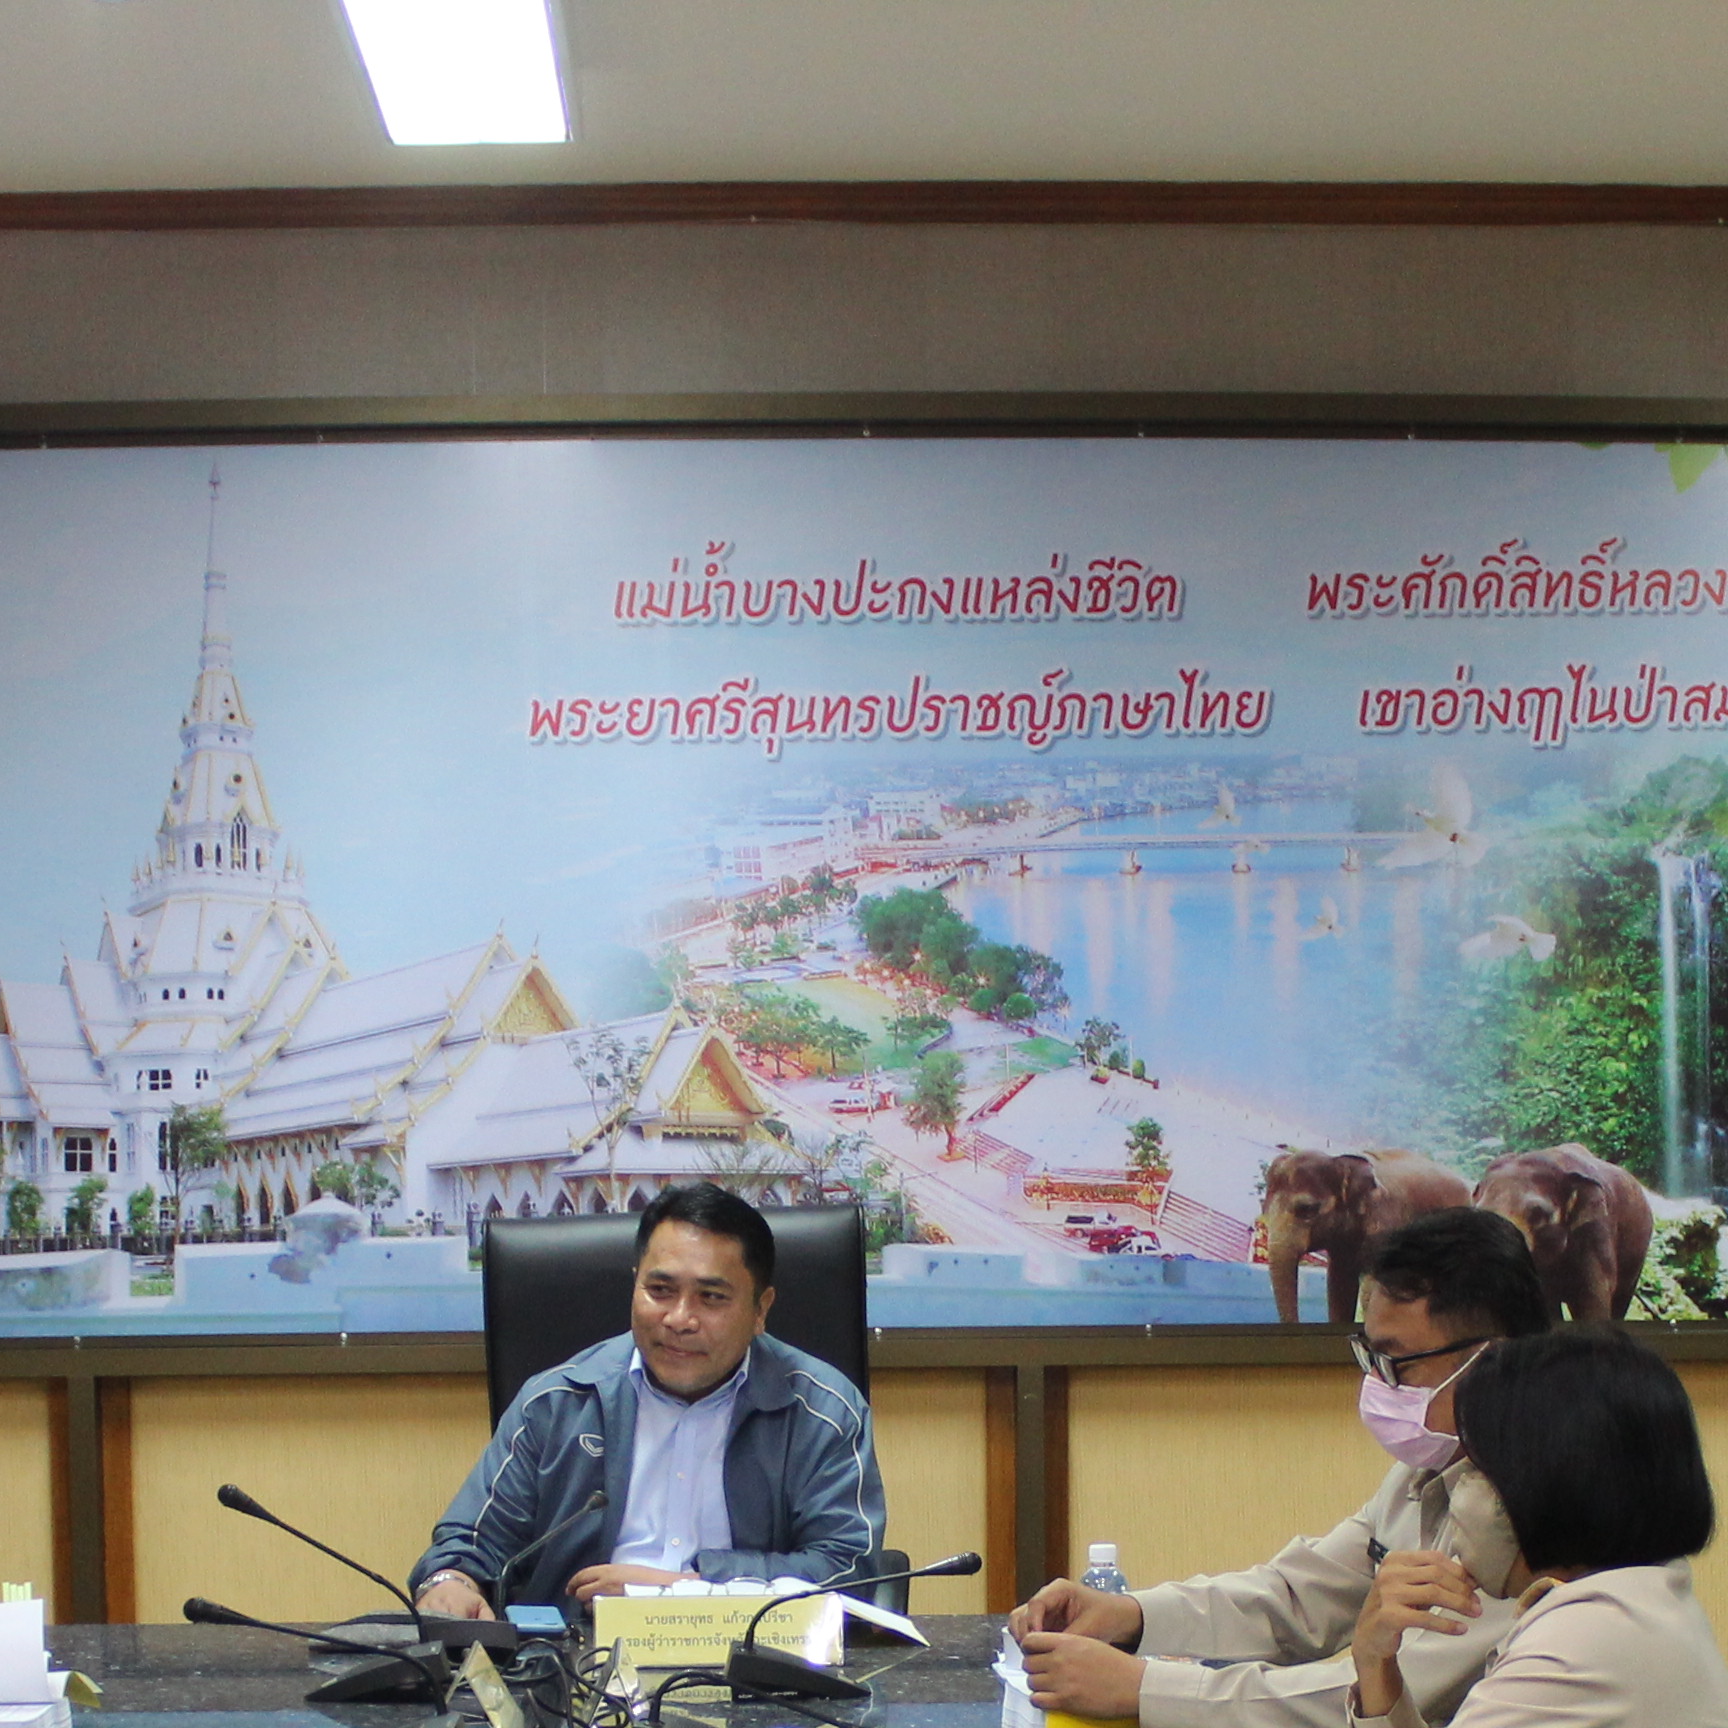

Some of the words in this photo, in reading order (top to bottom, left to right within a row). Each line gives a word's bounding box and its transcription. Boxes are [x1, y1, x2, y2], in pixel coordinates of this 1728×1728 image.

[612, 540, 1180, 620] แม่น้ำบางปะกงแหล่งชีวิต
[529, 667, 1268, 756] พระยาศรีสุนทรปราชญ์ภาษาไทย
[644, 1613, 714, 1629] นายสรายุทธ
